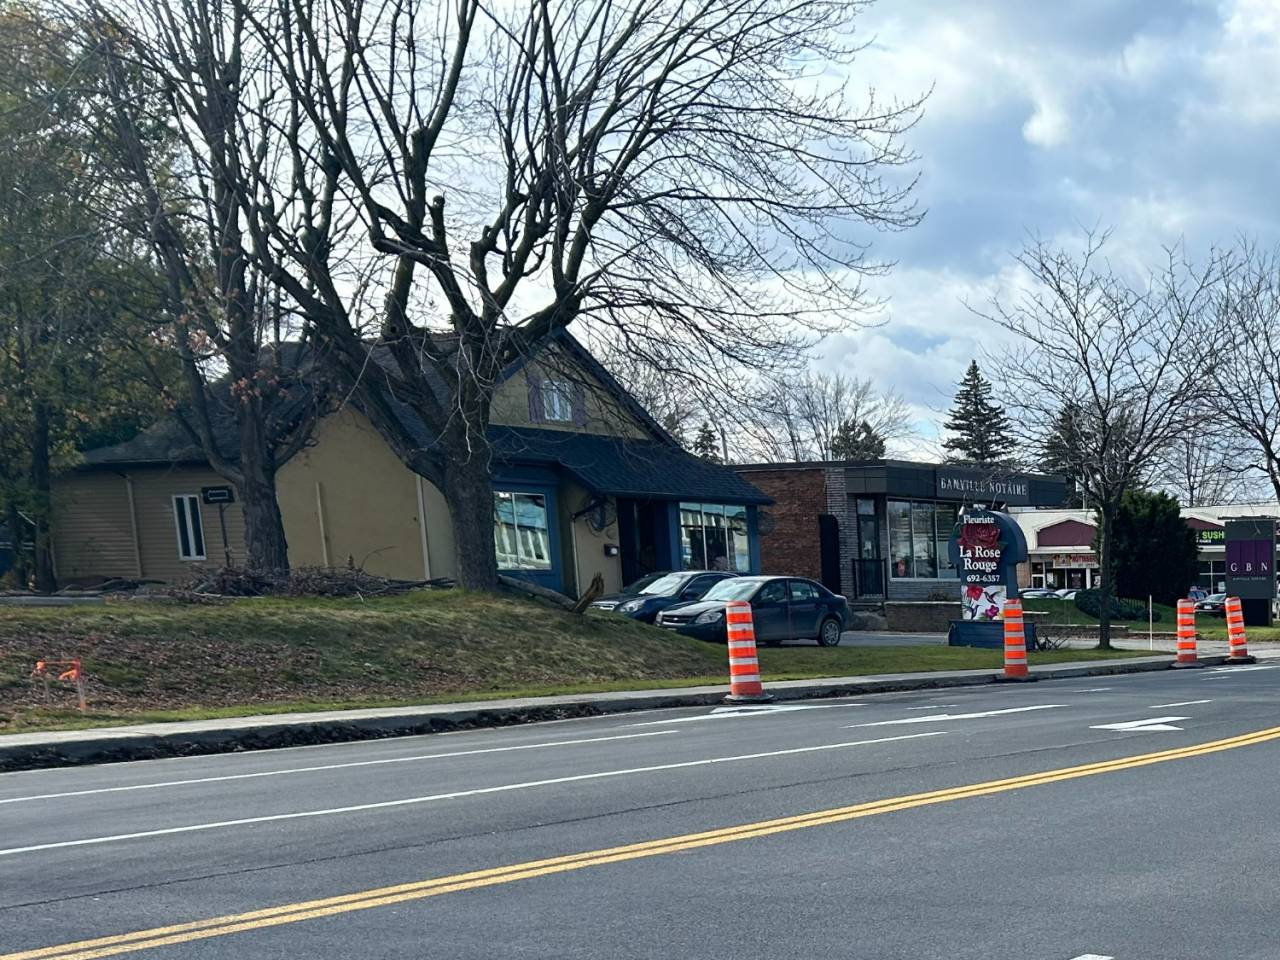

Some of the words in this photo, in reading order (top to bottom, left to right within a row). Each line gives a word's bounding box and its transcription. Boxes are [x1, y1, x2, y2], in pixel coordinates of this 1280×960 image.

[989, 481, 1027, 496] NOTAIRE
[963, 514, 995, 524] Fleuriste
[1202, 530, 1225, 539] SUSH
[959, 545, 972, 558] La
[975, 545, 1001, 558] Rose
[963, 558, 997, 573] Rouge
[966, 574, 1001, 582] 692-6357
